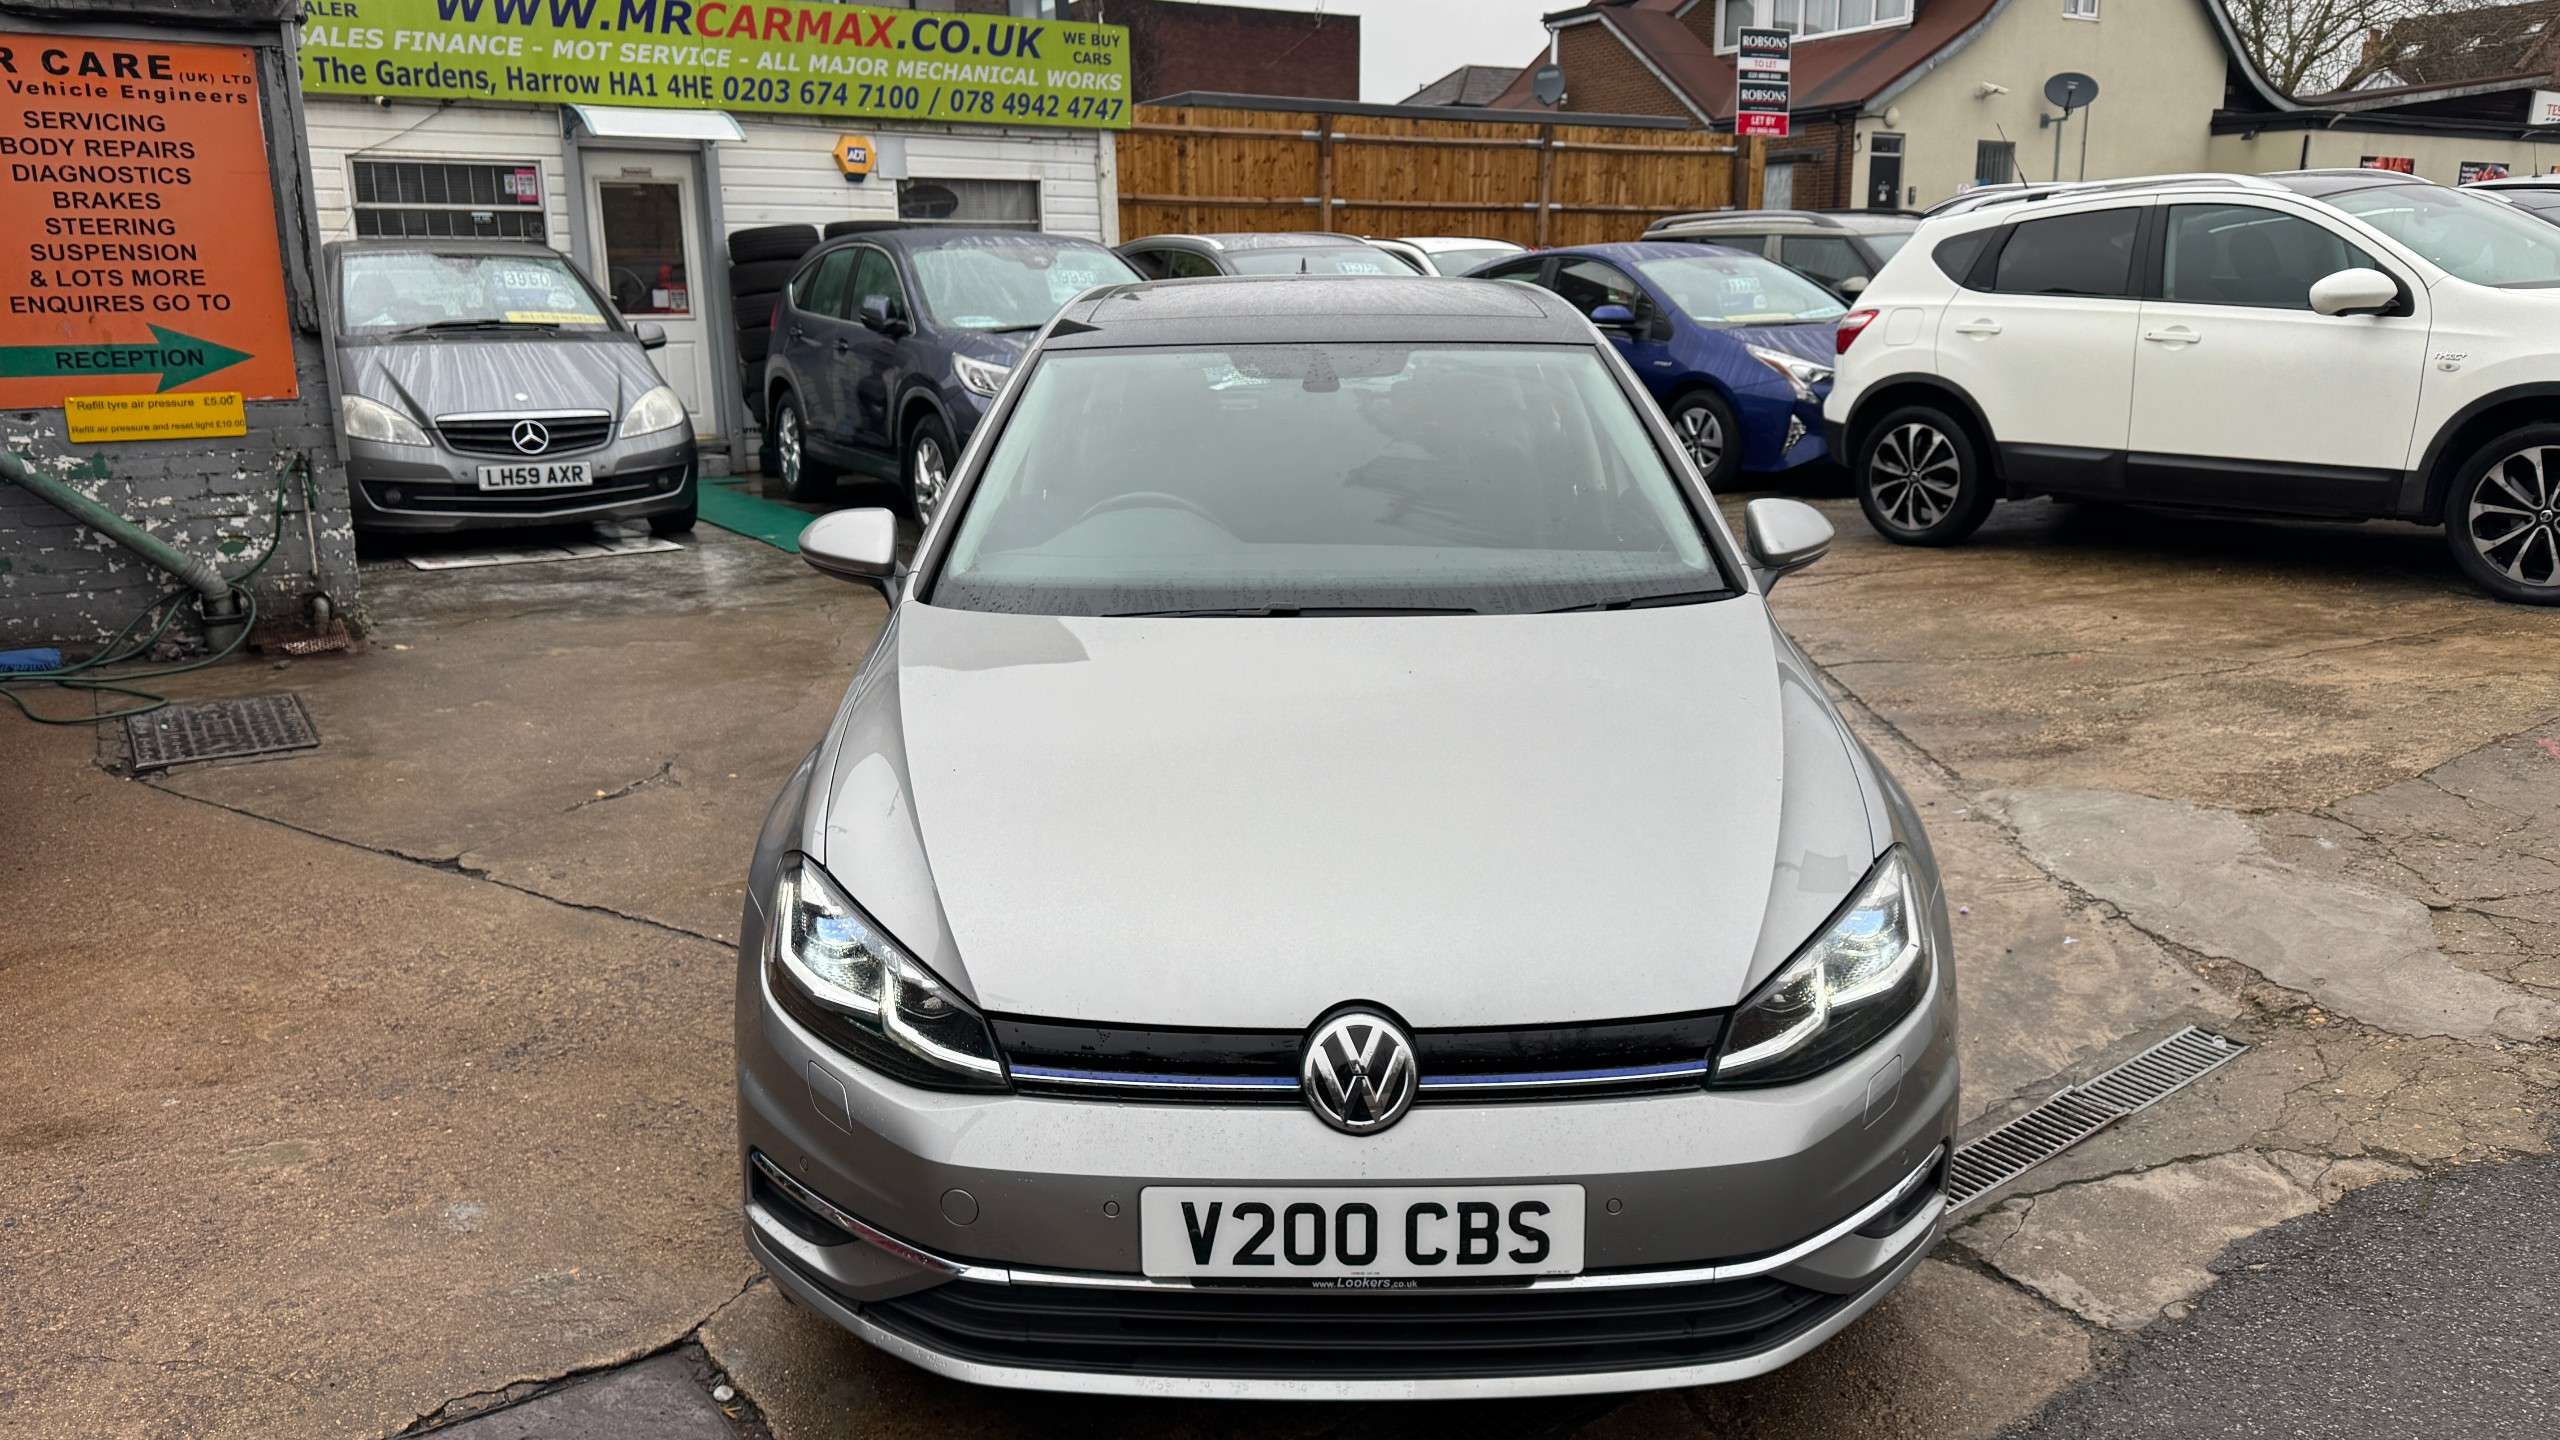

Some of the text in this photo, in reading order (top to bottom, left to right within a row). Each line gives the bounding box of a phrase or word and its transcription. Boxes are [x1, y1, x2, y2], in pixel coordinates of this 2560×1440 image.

[437, 0, 1044, 59] WWW.MRCARMAX.CO.UK
[1063, 32, 1121, 48] WE BUY
[1742, 35, 1788, 49] ROBSONS
[41, 49, 174, 81] CARE
[179, 72, 215, 86] (UK)
[222, 75, 252, 85] LTD
[394, 33, 524, 56] FINANCE
[552, 40, 612, 61] MOT
[620, 42, 732, 68] SERVICE
[757, 52, 800, 72] ALL
[809, 56, 888, 77] MAJOR
[897, 61, 1039, 86] MECHANICAL
[1047, 71, 1122, 91] WORKS
[1073, 51, 1112, 66] CARS
[8, 80, 249, 104] Vehicle Engineers
[313, 56, 367, 85] The
[376, 59, 497, 95] Gardens,
[506, 66, 600, 95] Harrow
[610, 72, 658, 98] HA1
[667, 75, 713, 100] 4HE
[723, 77, 790, 103] 0203
[800, 81, 848, 106] 674
[858, 84, 919, 110] 7100
[950, 89, 994, 114] 078
[1002, 93, 1060, 118] 4942
[1067, 97, 1123, 121] 4747
[1742, 89, 1787, 103] ROBSONS
[23, 111, 166, 132] SERVICING
[0, 137, 195, 159] BODY REPAIRS
[848, 149, 866, 161] ADT
[12, 164, 192, 185] DIAGNOSTICS
[53, 191, 161, 210] BRAKES
[45, 217, 176, 236] STEERING
[30, 243, 197, 261] SUSPENSION
[29, 269, 206, 287] & LOTS MORE
[10, 294, 231, 314] ENQUIRES GO TO
[55, 349, 205, 369] RECEPTION
[77, 395, 234, 412] Refill tyre air pressure £5.00
[111, 424, 152, 434] pressure
[153, 422, 169, 431] and
[487, 466, 583, 486] LH59 AXR
[1180, 1201, 1551, 1266] V200 CBS
[1312, 1277, 1418, 1289] www.Lookers.co.uk
